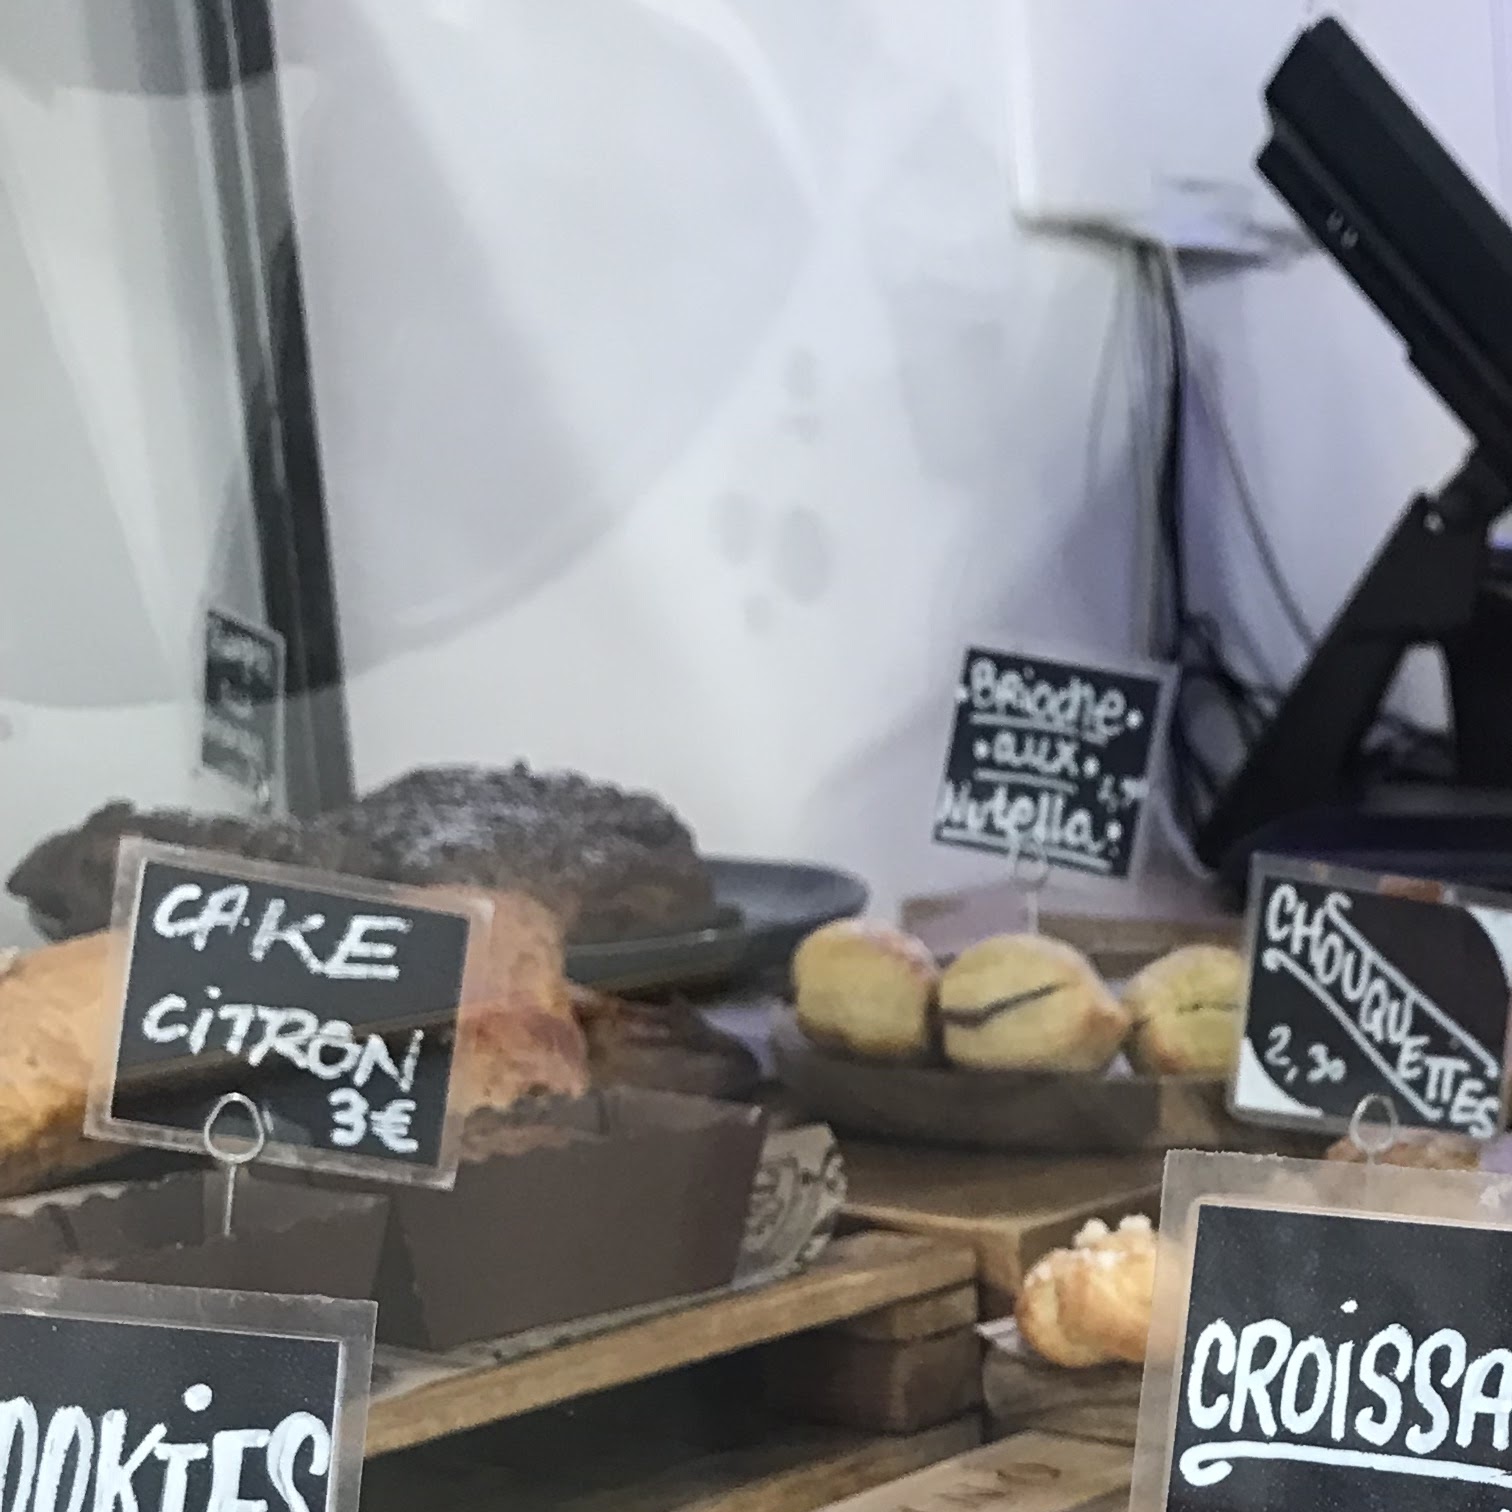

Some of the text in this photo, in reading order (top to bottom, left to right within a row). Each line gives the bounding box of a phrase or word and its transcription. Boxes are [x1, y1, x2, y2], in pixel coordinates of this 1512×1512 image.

[993, 732, 1079, 777] aux
[153, 884, 412, 980] CAKE
[1265, 883, 1500, 1138] CHOUQUETTES
[328, 1087, 420, 1153] 3€
